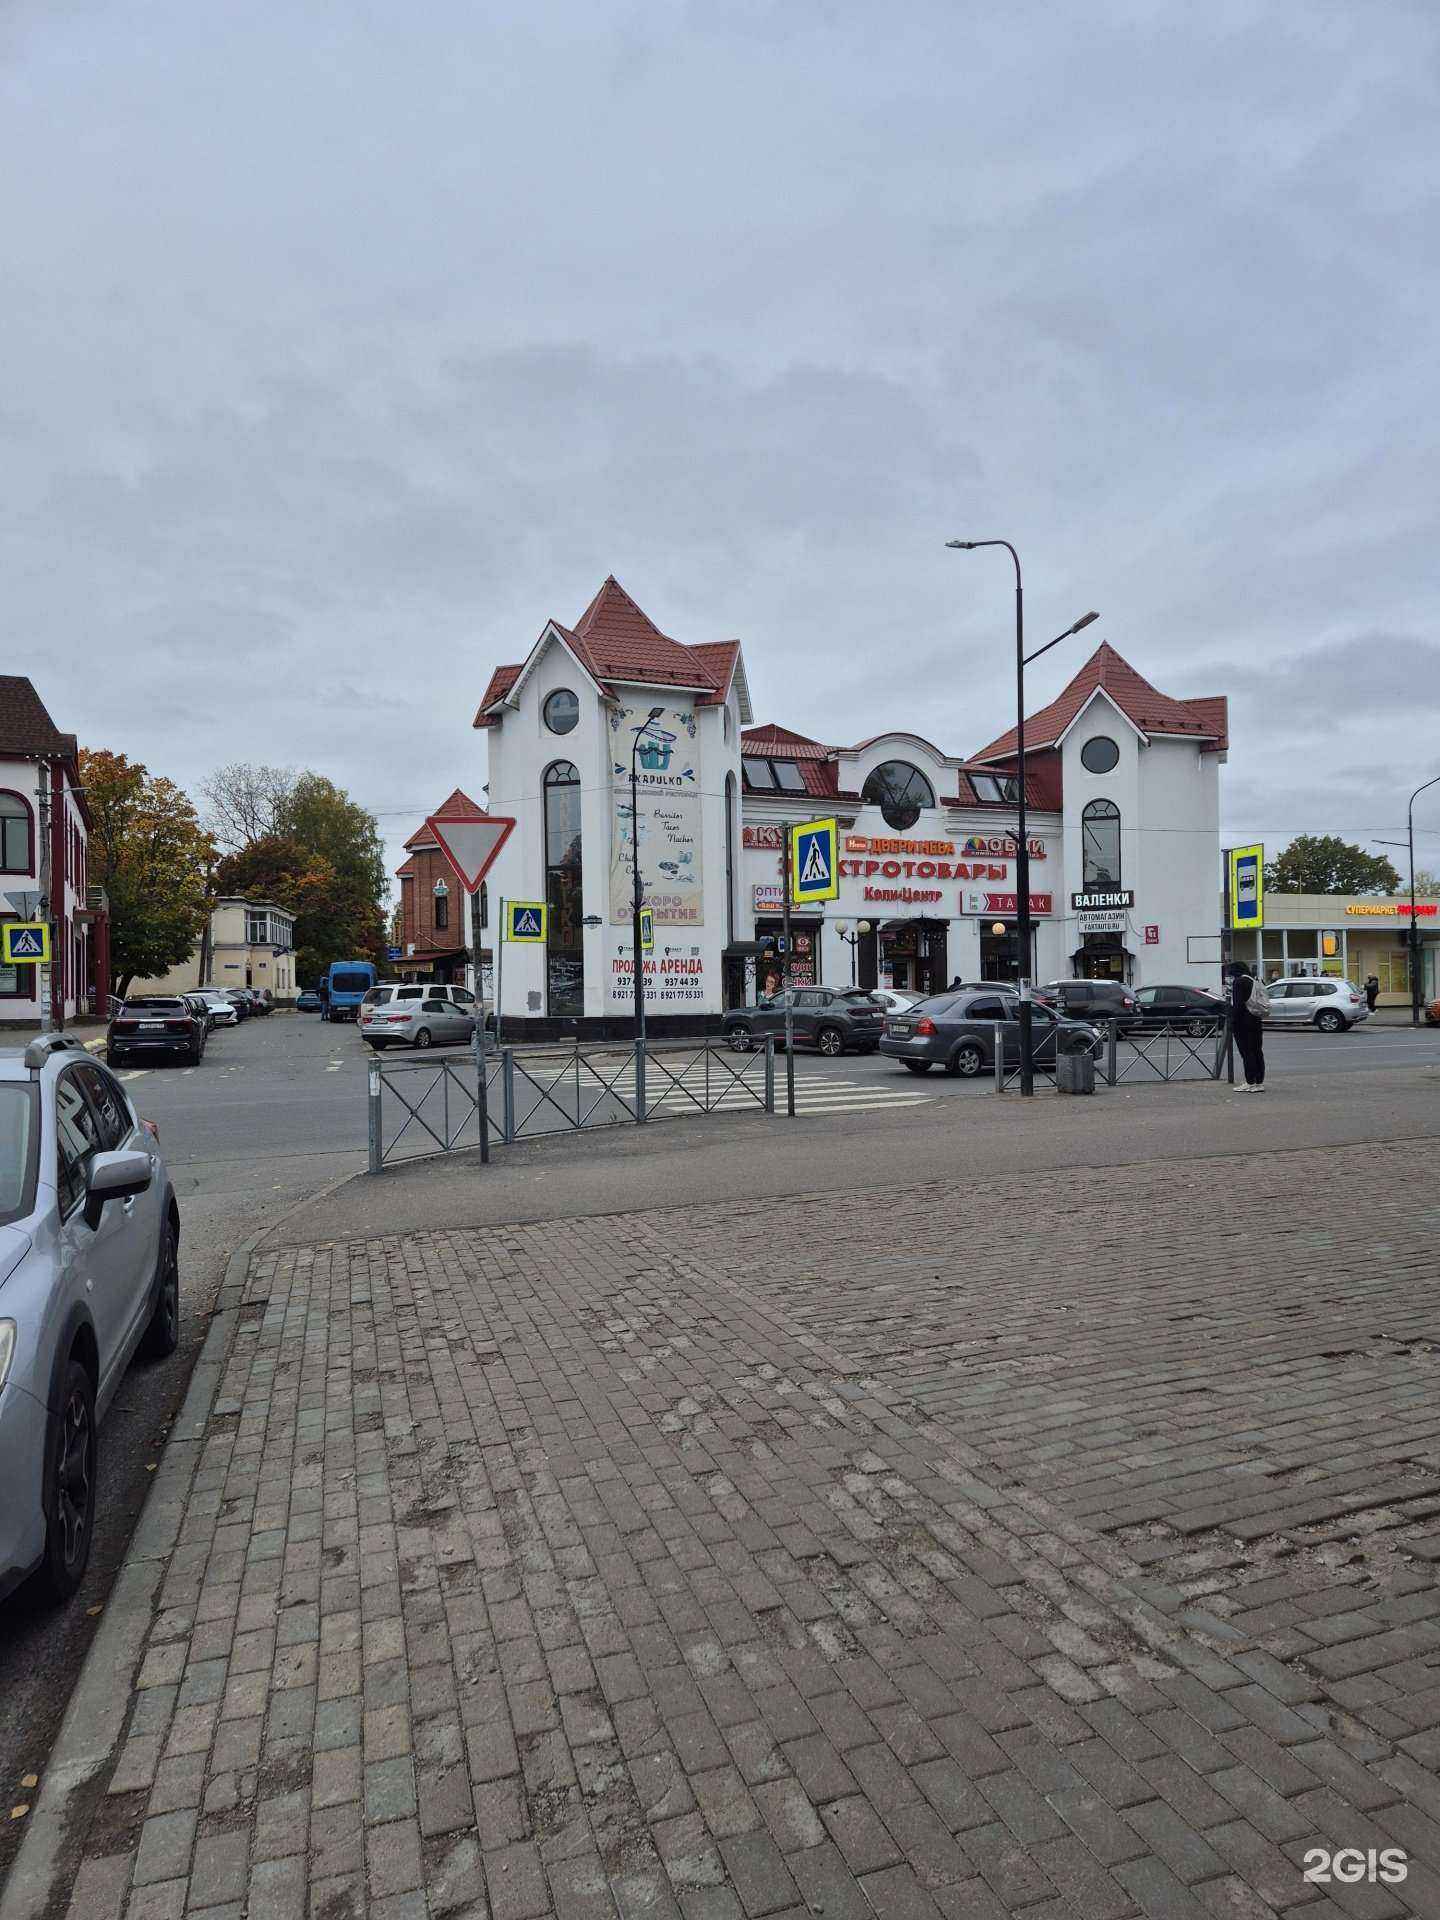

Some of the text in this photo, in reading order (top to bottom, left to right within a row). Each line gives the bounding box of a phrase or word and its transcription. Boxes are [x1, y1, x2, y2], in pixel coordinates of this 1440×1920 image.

[988, 838, 1045, 852] ОБИ
[996, 897, 1045, 909] ТААК
[1075, 893, 1130, 907] ВАЛЕНКИ
[1080, 912, 1125, 921] АВТОМАГАЗИН
[1346, 905, 1399, 915] СУПЕРМАРКЕТ
[612, 960, 657, 974] ПРОДЖА
[660, 959, 703, 975] АРЕНДА
[664, 978, 699, 987] 937 44 39
